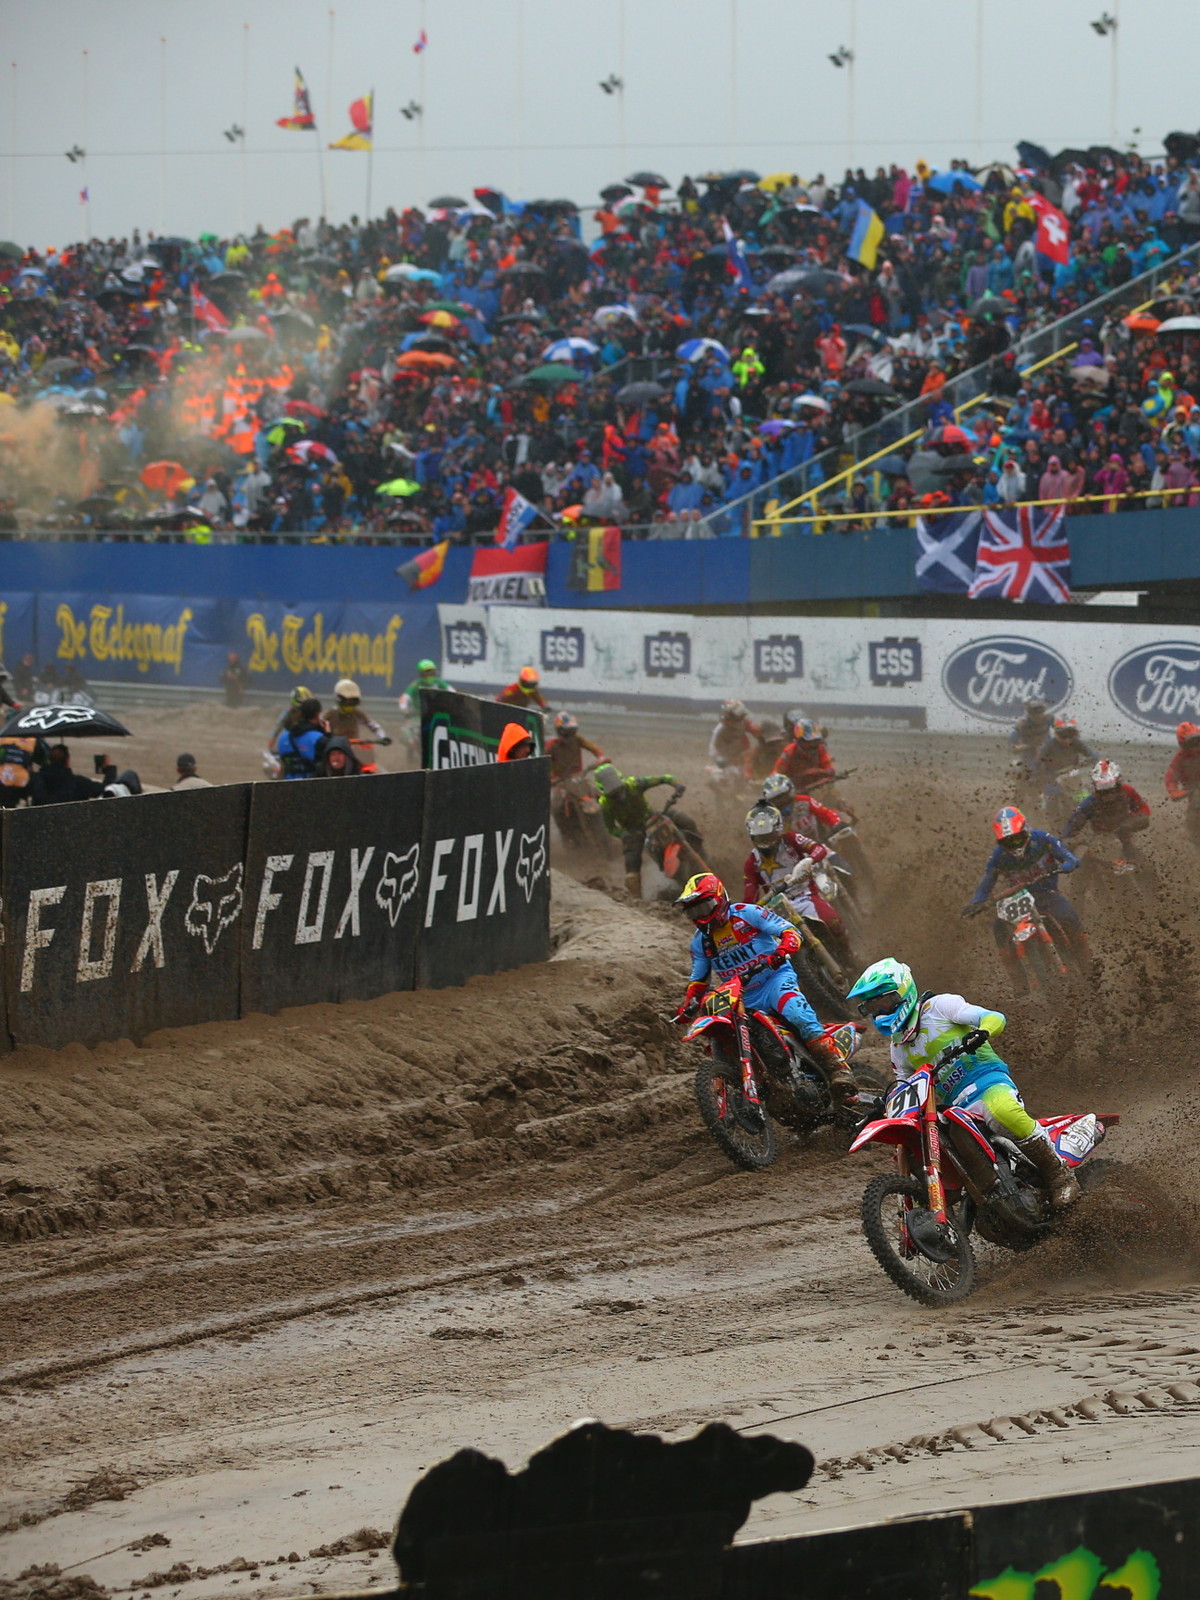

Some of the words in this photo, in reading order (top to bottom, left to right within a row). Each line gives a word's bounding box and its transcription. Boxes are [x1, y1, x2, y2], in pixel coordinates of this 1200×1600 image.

[55, 603, 87, 659] De
[246, 612, 280, 673] De
[451, 630, 482, 656] ESS
[544, 635, 579, 662] ESS
[649, 642, 685, 668] ESS
[759, 645, 796, 672] ESS
[875, 647, 915, 676] ESS
[967, 648, 1048, 705] Ford
[424, 829, 514, 928] FOX
[251, 846, 375, 951] FOX
[1005, 896, 1032, 921] 88
[20, 870, 180, 993] FOX
[713, 942, 757, 970] KENNY
[946, 1064, 965, 1087] HSF
[891, 1083, 919, 1118] 91
